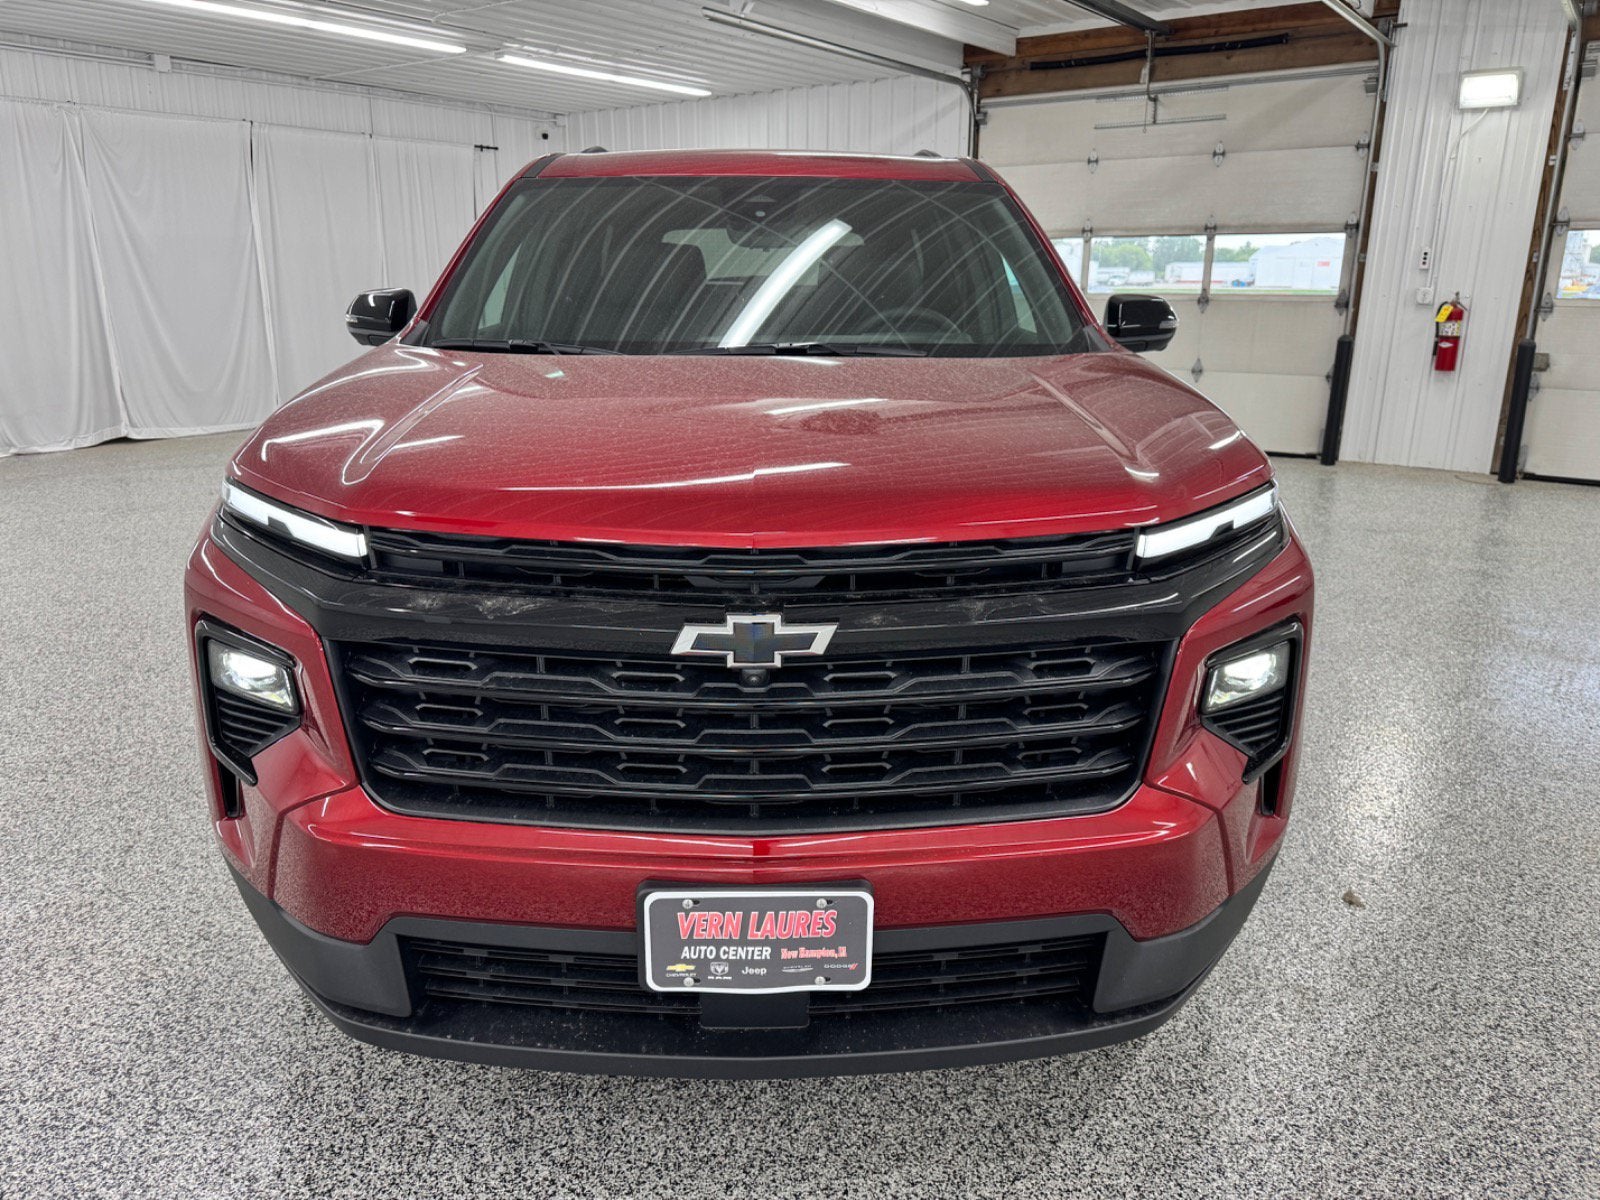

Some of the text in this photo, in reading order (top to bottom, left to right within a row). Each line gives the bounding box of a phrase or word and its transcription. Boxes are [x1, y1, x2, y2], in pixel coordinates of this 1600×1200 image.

[677, 909, 838, 940] VERN LAURES
[680, 945, 772, 960] AUTO CENTER
[741, 966, 767, 977] Jeep
